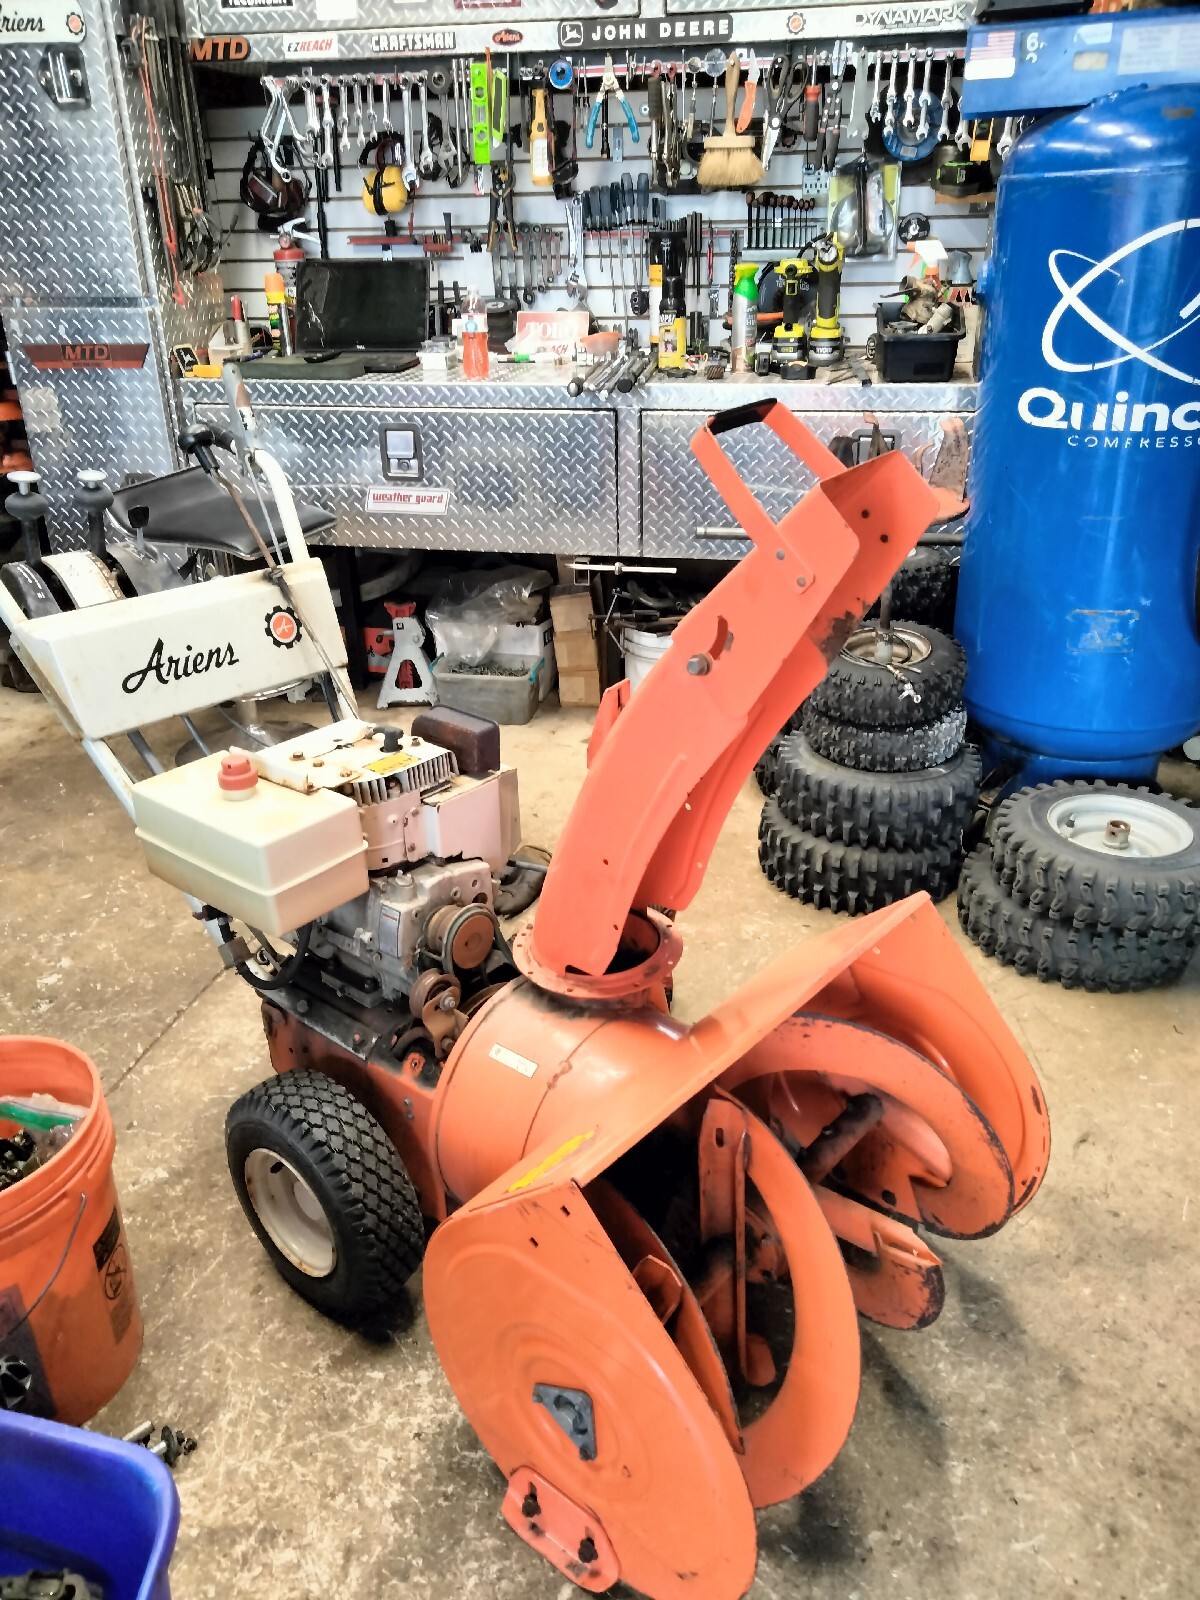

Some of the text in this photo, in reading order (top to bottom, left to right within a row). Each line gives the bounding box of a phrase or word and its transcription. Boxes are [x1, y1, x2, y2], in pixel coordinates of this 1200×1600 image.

[0, 3, 45, 32] riens
[855, 4, 968, 26] DYNAMARK
[592, 19, 729, 41] JOHN DEERE
[191, 36, 248, 60] MTD
[371, 32, 457, 52] CRAFTSMAN
[65, 345, 108, 360] MTD
[1067, 435, 1200, 449] COMPRESS
[372, 492, 443, 505] weather guard
[122, 637, 239, 694] Ariens
